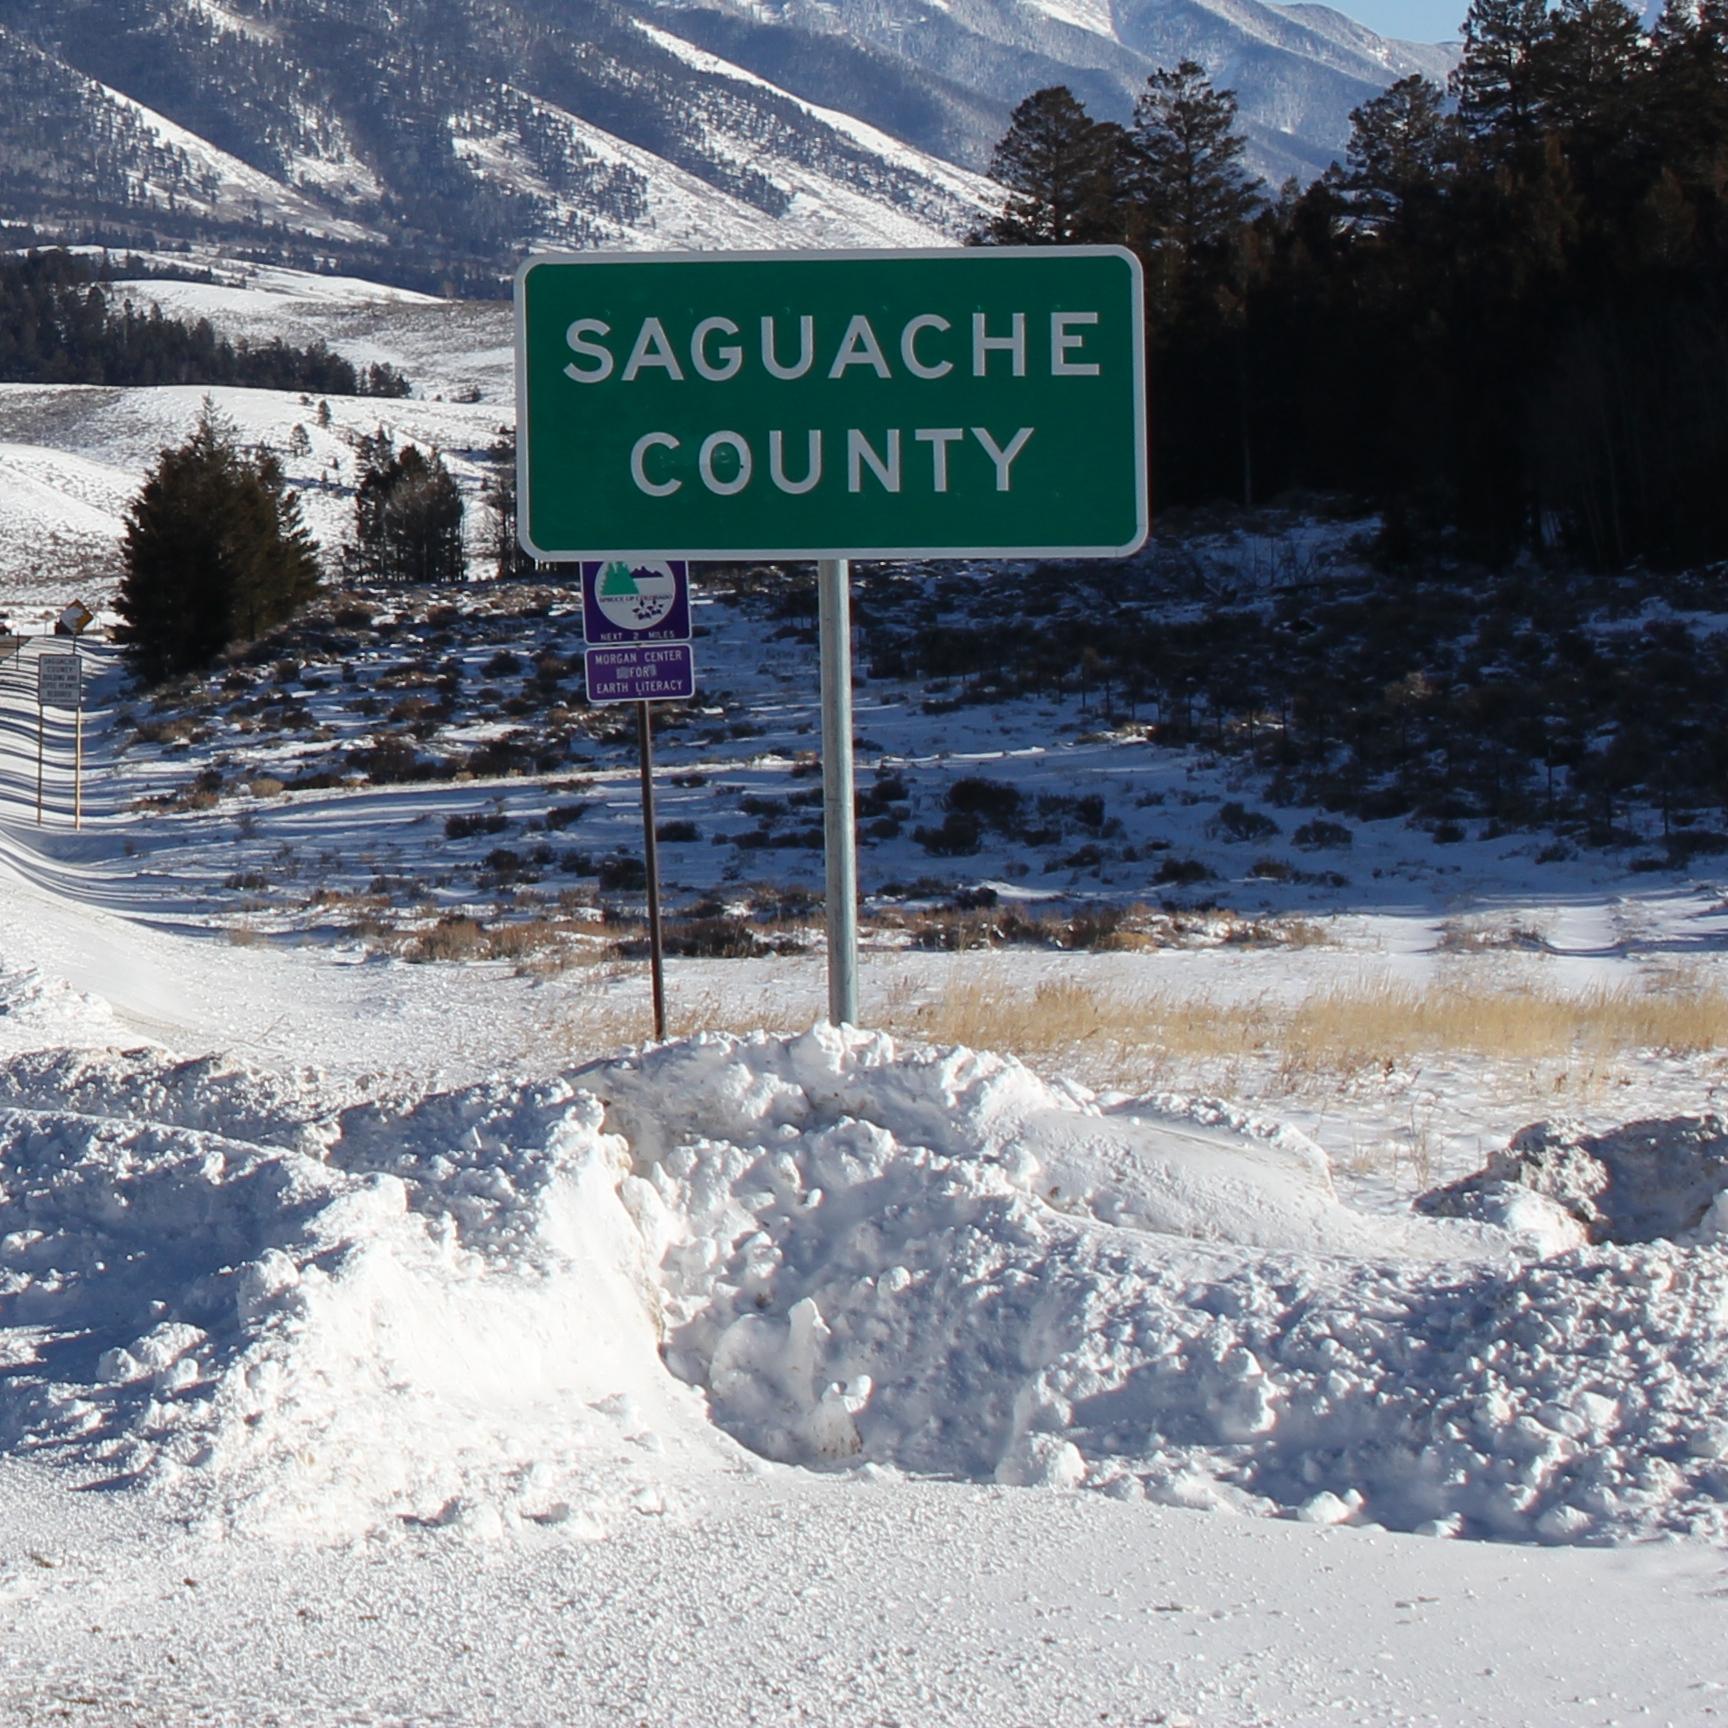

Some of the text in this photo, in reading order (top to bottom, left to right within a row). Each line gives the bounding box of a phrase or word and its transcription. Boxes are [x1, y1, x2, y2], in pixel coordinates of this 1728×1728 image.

[563, 312, 1101, 385] SAGUACHE
[630, 426, 1035, 497] COUNTY
[600, 630, 675, 641] NEXT 2 MILES
[595, 650, 682, 665] MORGAN CENTER
[629, 666, 650, 678] FOR
[597, 680, 683, 694] EARTH LITERACY
